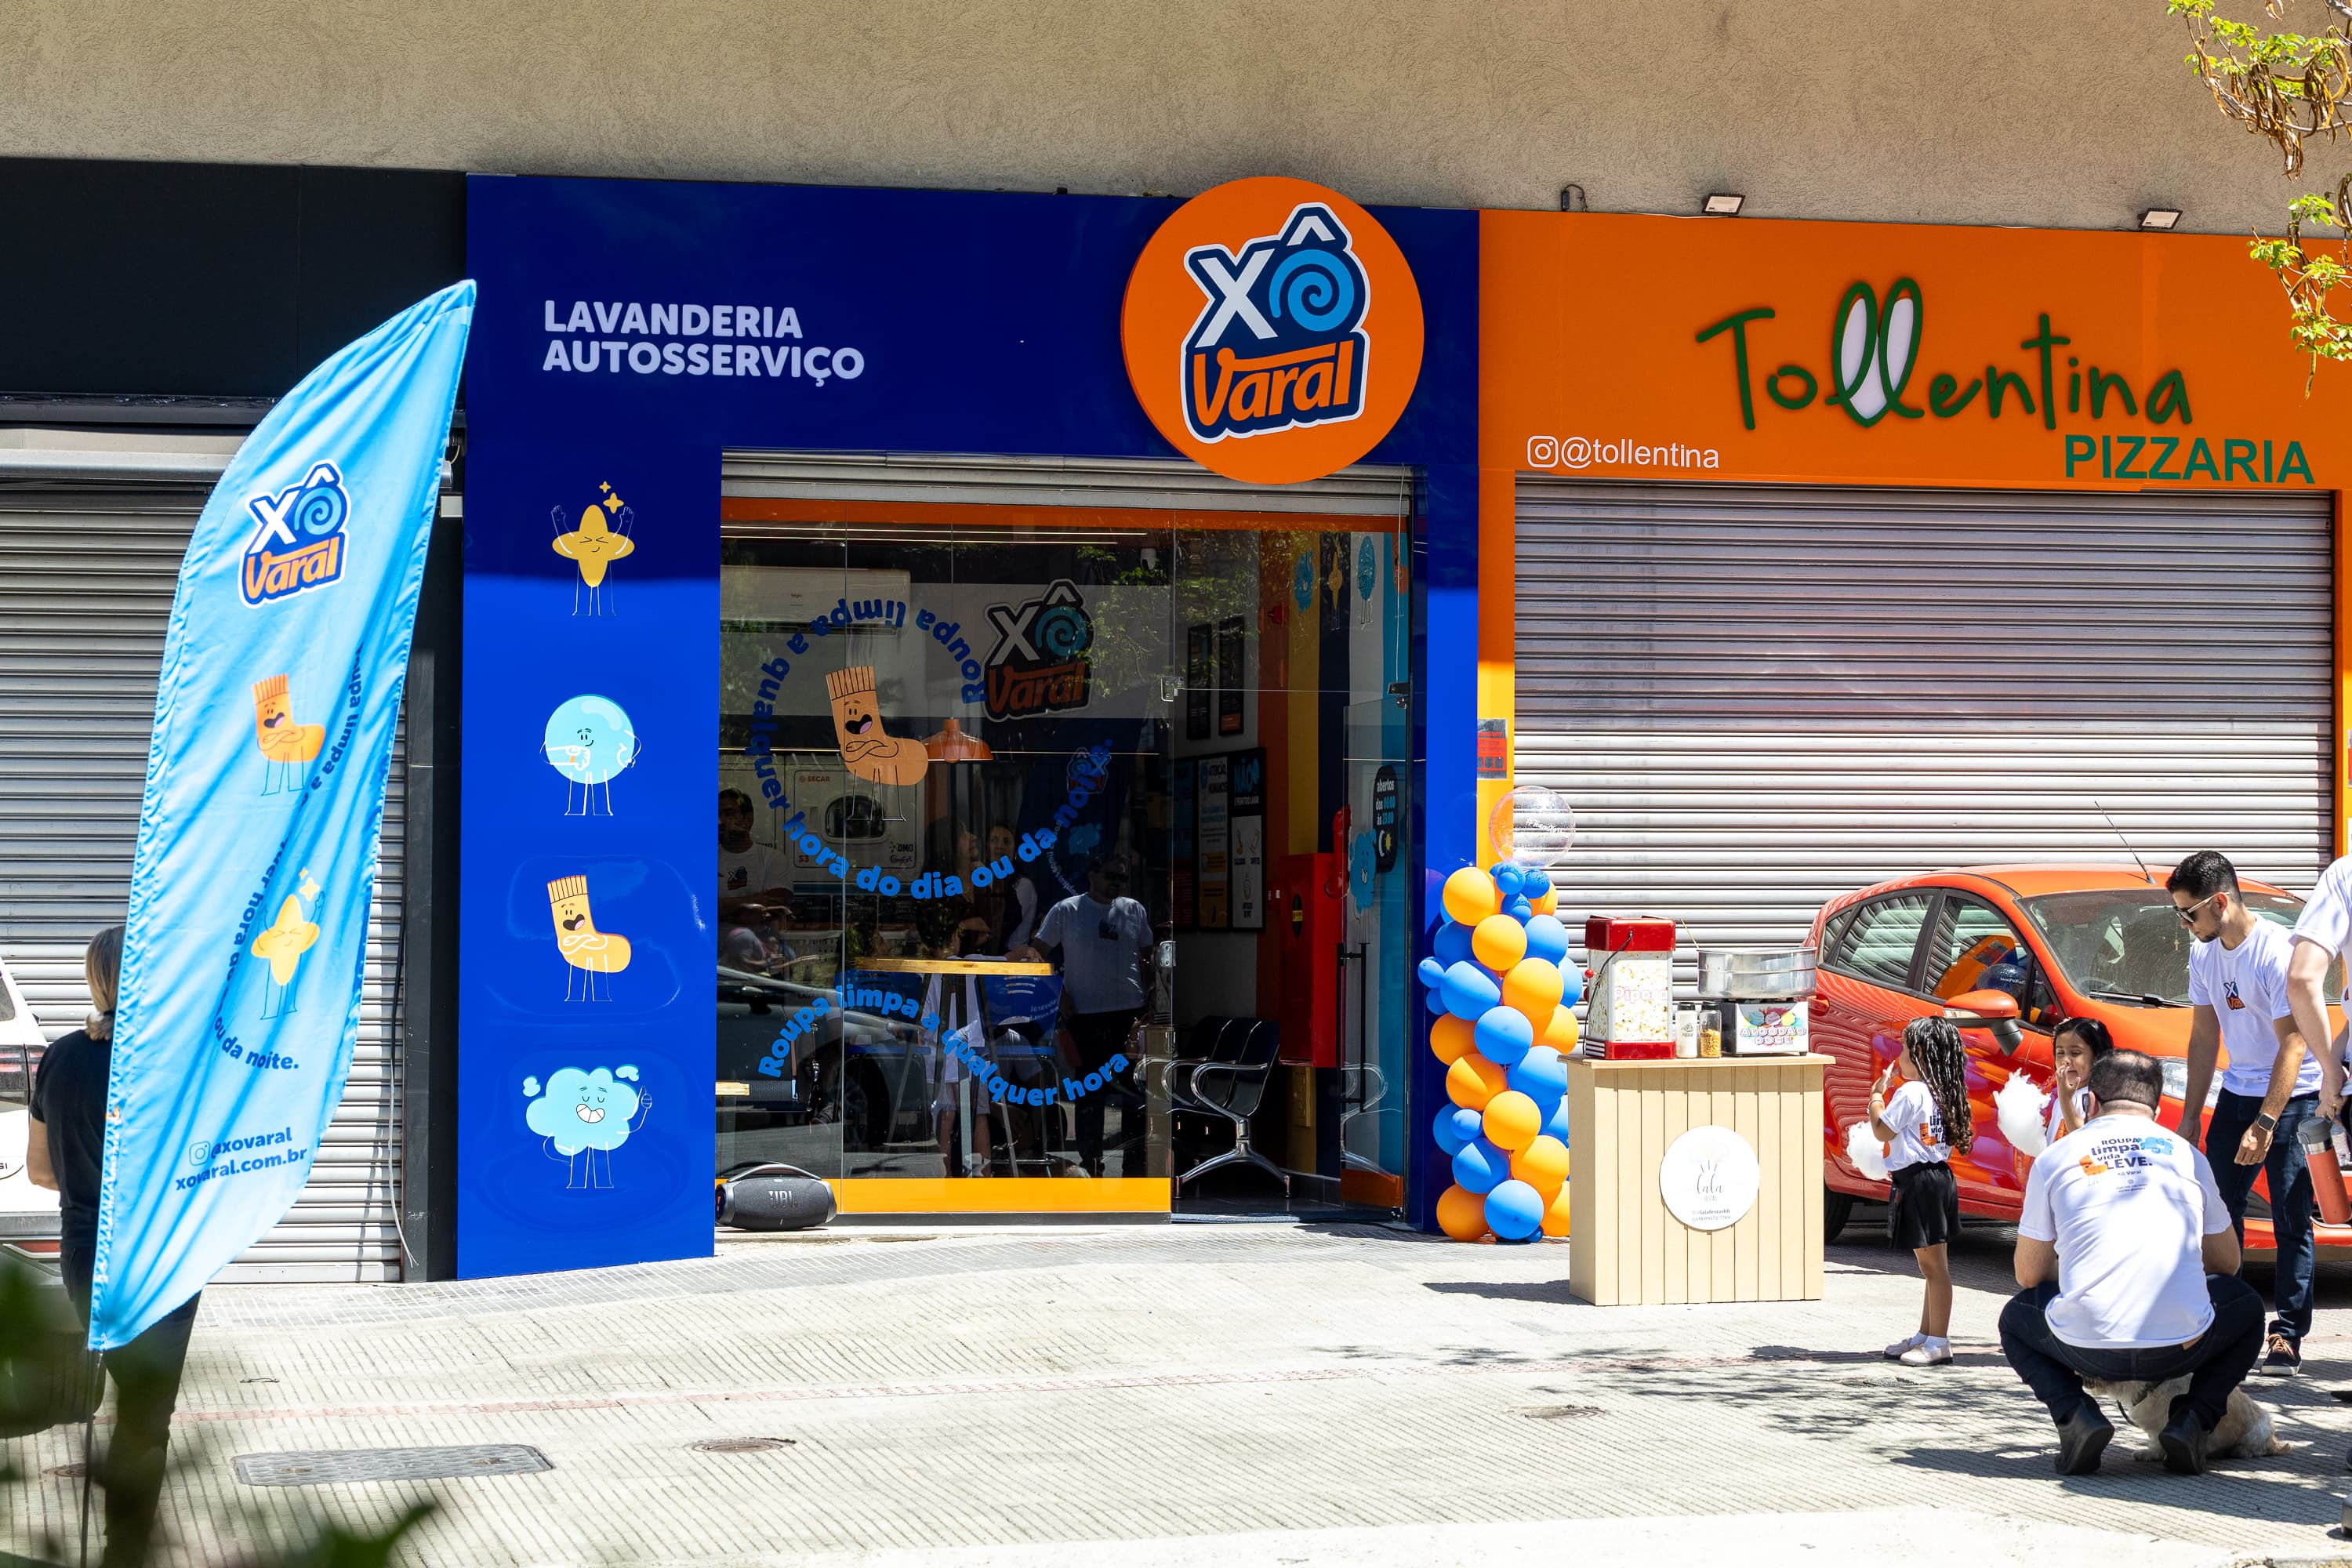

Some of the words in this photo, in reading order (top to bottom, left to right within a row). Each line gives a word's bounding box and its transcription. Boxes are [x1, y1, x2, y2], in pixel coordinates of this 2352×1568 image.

[544, 299, 804, 339] LAVANDERIA
[543, 339, 866, 387] AUTOSSERVIÇO
[1695, 277, 2193, 431] Tollentina
[1193, 339, 1355, 426] Varal
[1561, 436, 1719, 469] @tollentina
[2063, 433, 2317, 485] PIZZARIA
[245, 535, 340, 599] Varal
[810, 598, 906, 637] limpa
[786, 632, 810, 655] a
[916, 608, 989, 704] Roupa
[321, 713, 359, 775] limpa
[745, 657, 790, 809] qualquer
[310, 775, 323, 790] a
[1376, 778, 1395, 793] abertos
[782, 809, 850, 879] hora
[1018, 826, 1058, 863] da
[855, 866, 901, 897] do
[910, 871, 964, 900] dia
[971, 855, 1015, 888] ou
[234, 891, 264, 946] hora
[214, 1017, 226, 1042] ou
[758, 996, 830, 1078] Roupa
[835, 983, 920, 1018] limpa
[921, 1011, 941, 1033] a
[941, 1029, 1058, 1107] qualquer
[1062, 1052, 1130, 1102] hora
[1755, 1036, 1793, 1046] DOCE
[221, 1036, 243, 1060] da
[245, 1051, 299, 1070] noite.
[211, 1127, 292, 1160] @xovaral
[2097, 1153, 2121, 1162] vida
[2101, 1137, 2140, 1145] ROUPA
[176, 1149, 307, 1190] xovaral.com.br
[2104, 1156, 2153, 1170] LEVE.
[768, 1190, 798, 1208] JBL
